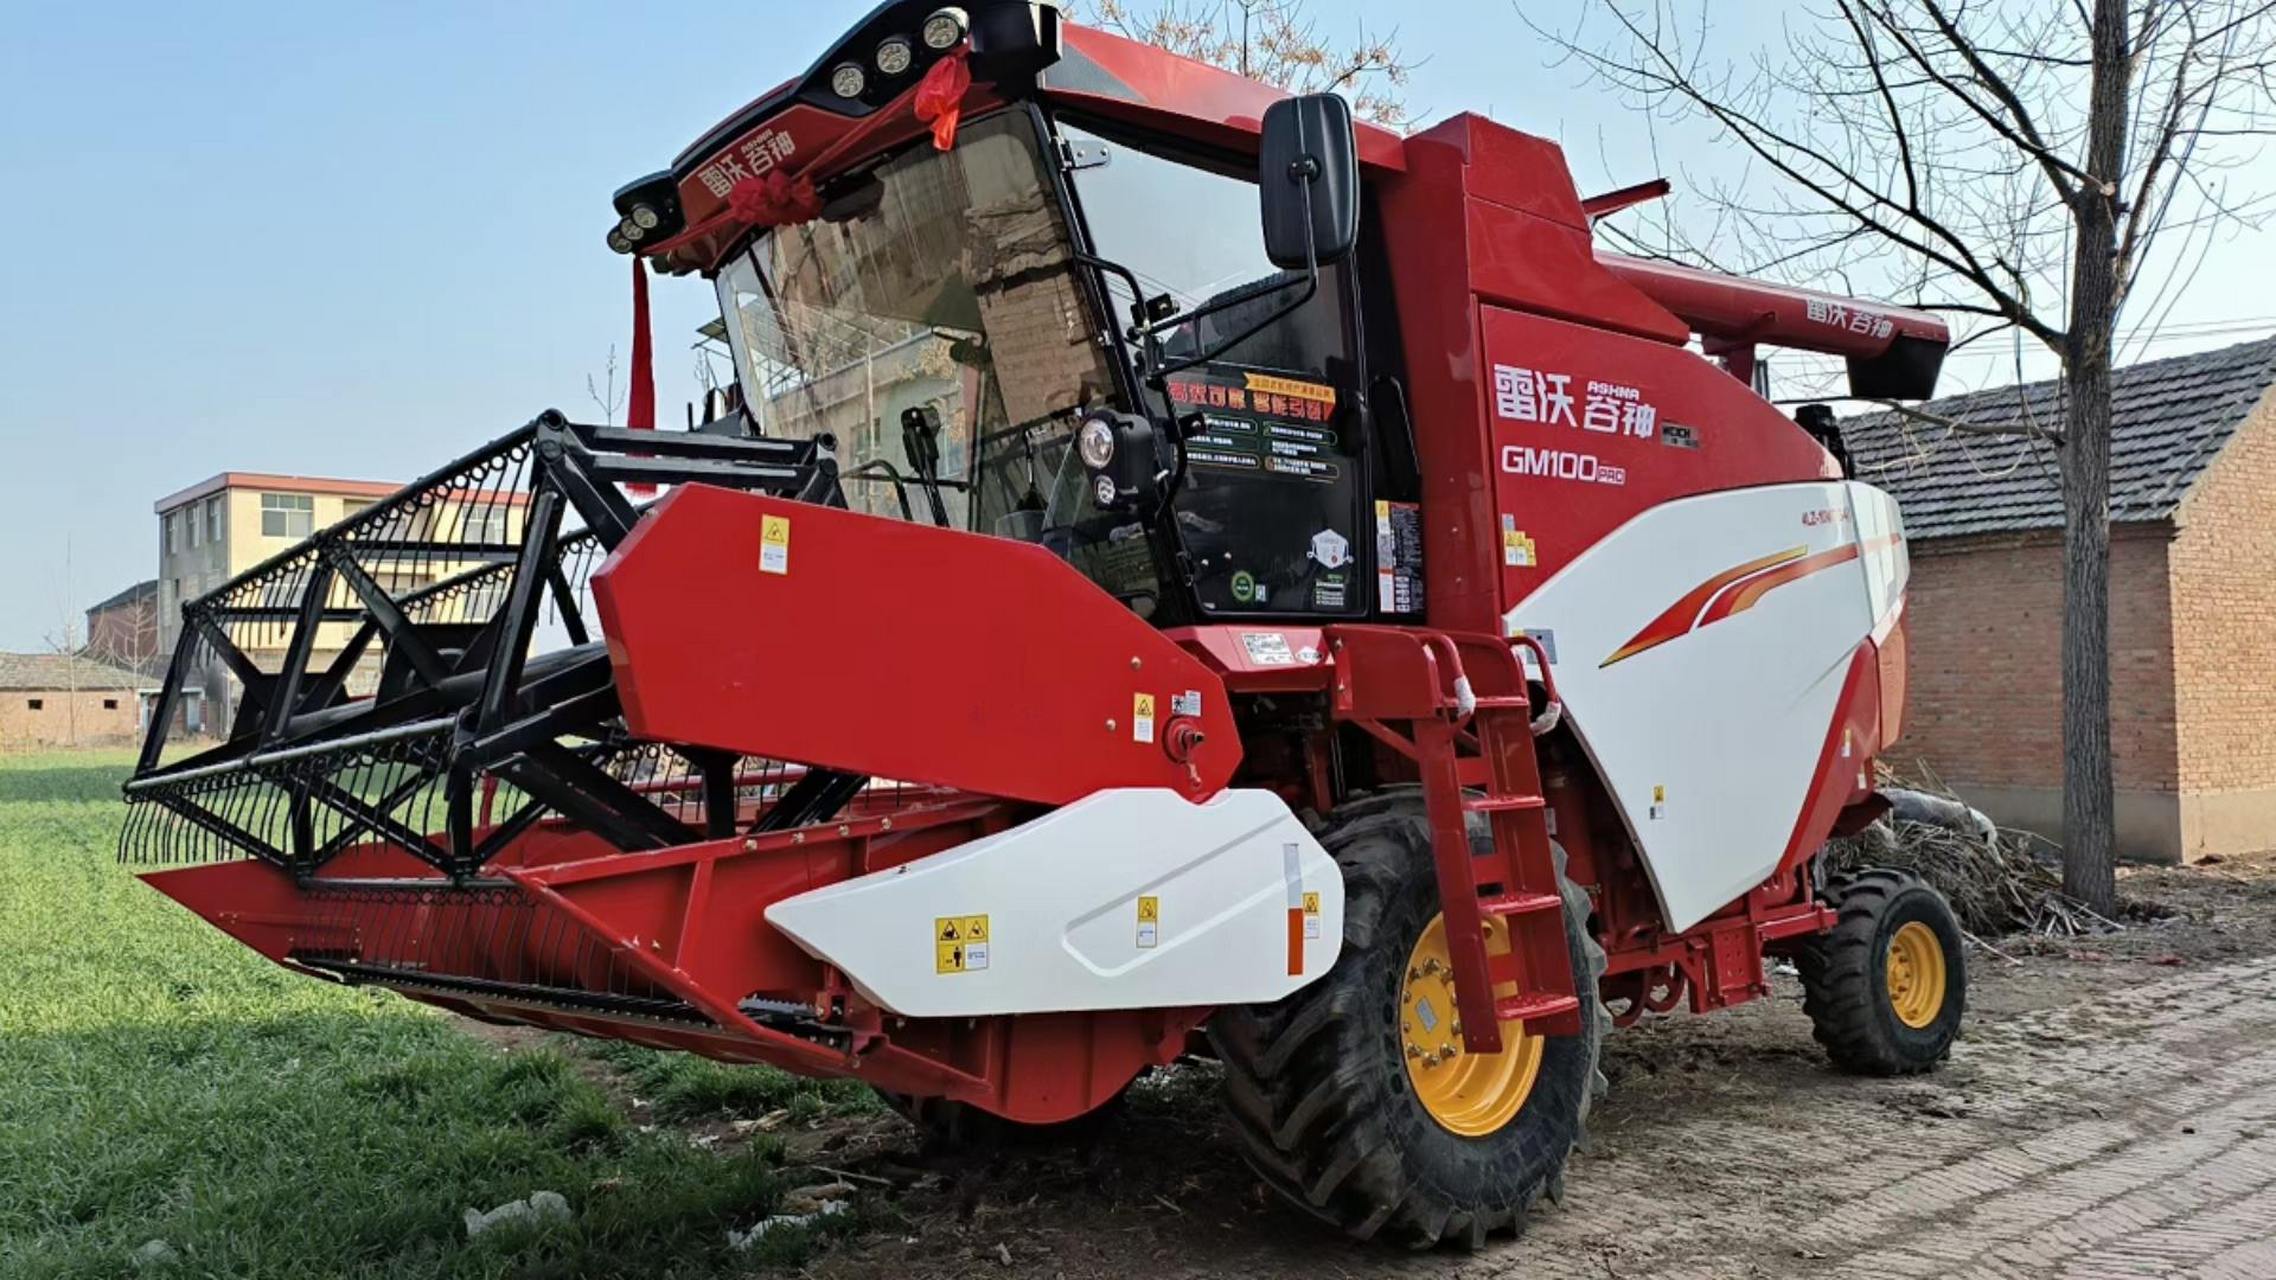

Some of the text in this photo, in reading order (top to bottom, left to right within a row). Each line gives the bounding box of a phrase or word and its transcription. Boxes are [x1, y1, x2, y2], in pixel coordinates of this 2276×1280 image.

[697, 130, 796, 198] 雷沃谷神
[1806, 297, 1893, 339] 雷沃谷神
[1494, 363, 1657, 438] 雷沃谷神
[1587, 380, 1640, 400] ASHMA
[1501, 445, 1598, 481] GM100
